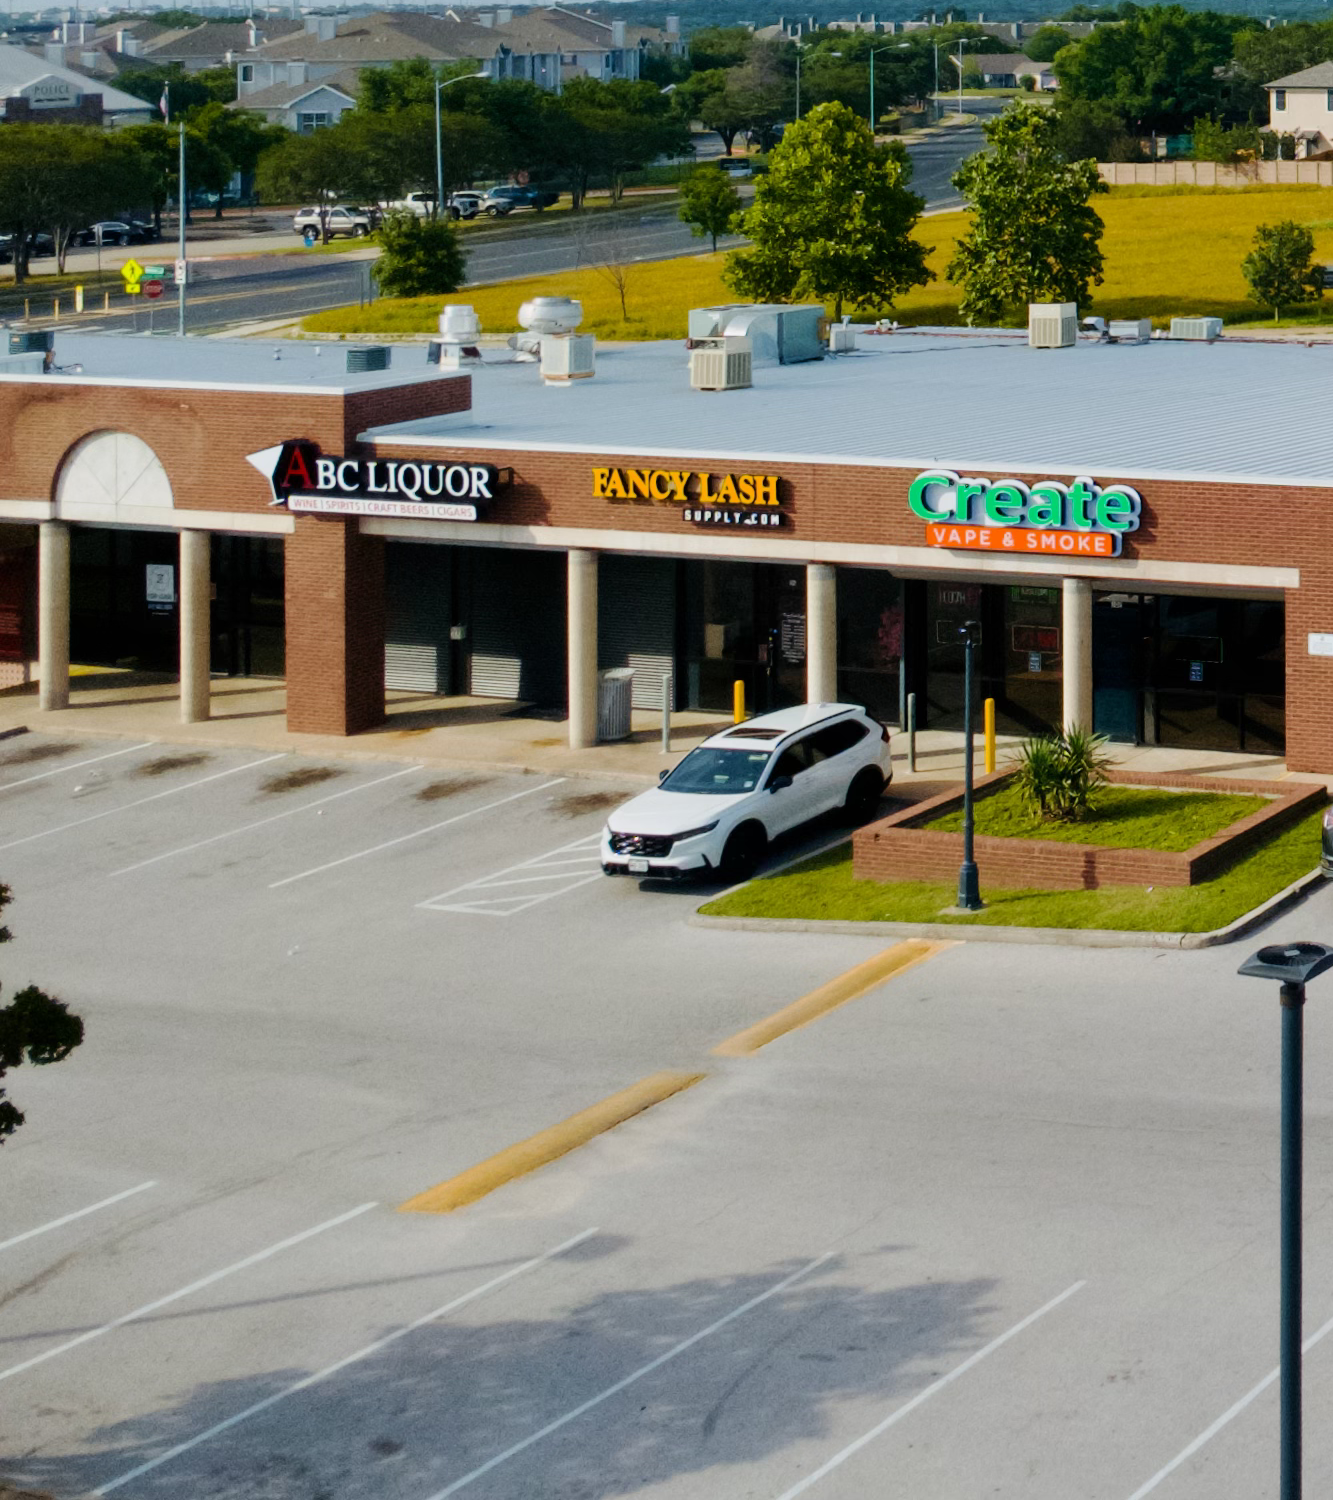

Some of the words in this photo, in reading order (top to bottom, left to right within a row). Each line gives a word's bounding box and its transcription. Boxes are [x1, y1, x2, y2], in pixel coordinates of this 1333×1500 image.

[34, 84, 70, 95] POLICE
[281, 446, 361, 491] ABC
[366, 461, 494, 501] LIQUOR
[591, 467, 691, 501] FANCY
[698, 472, 780, 506] LASH
[293, 498, 318, 510] WINE
[325, 500, 361, 512] SPIRITS
[367, 503, 398, 514] CRAFT
[400, 505, 430, 516] BEERS
[437, 507, 473, 519] CIGARS
[908, 474, 1133, 530] Create
[684, 509, 780, 526] SUPPLY.COM
[933, 528, 991, 546] VAPE
[1001, 532, 1015, 547] &
[1026, 533, 1106, 553] SMOKE
